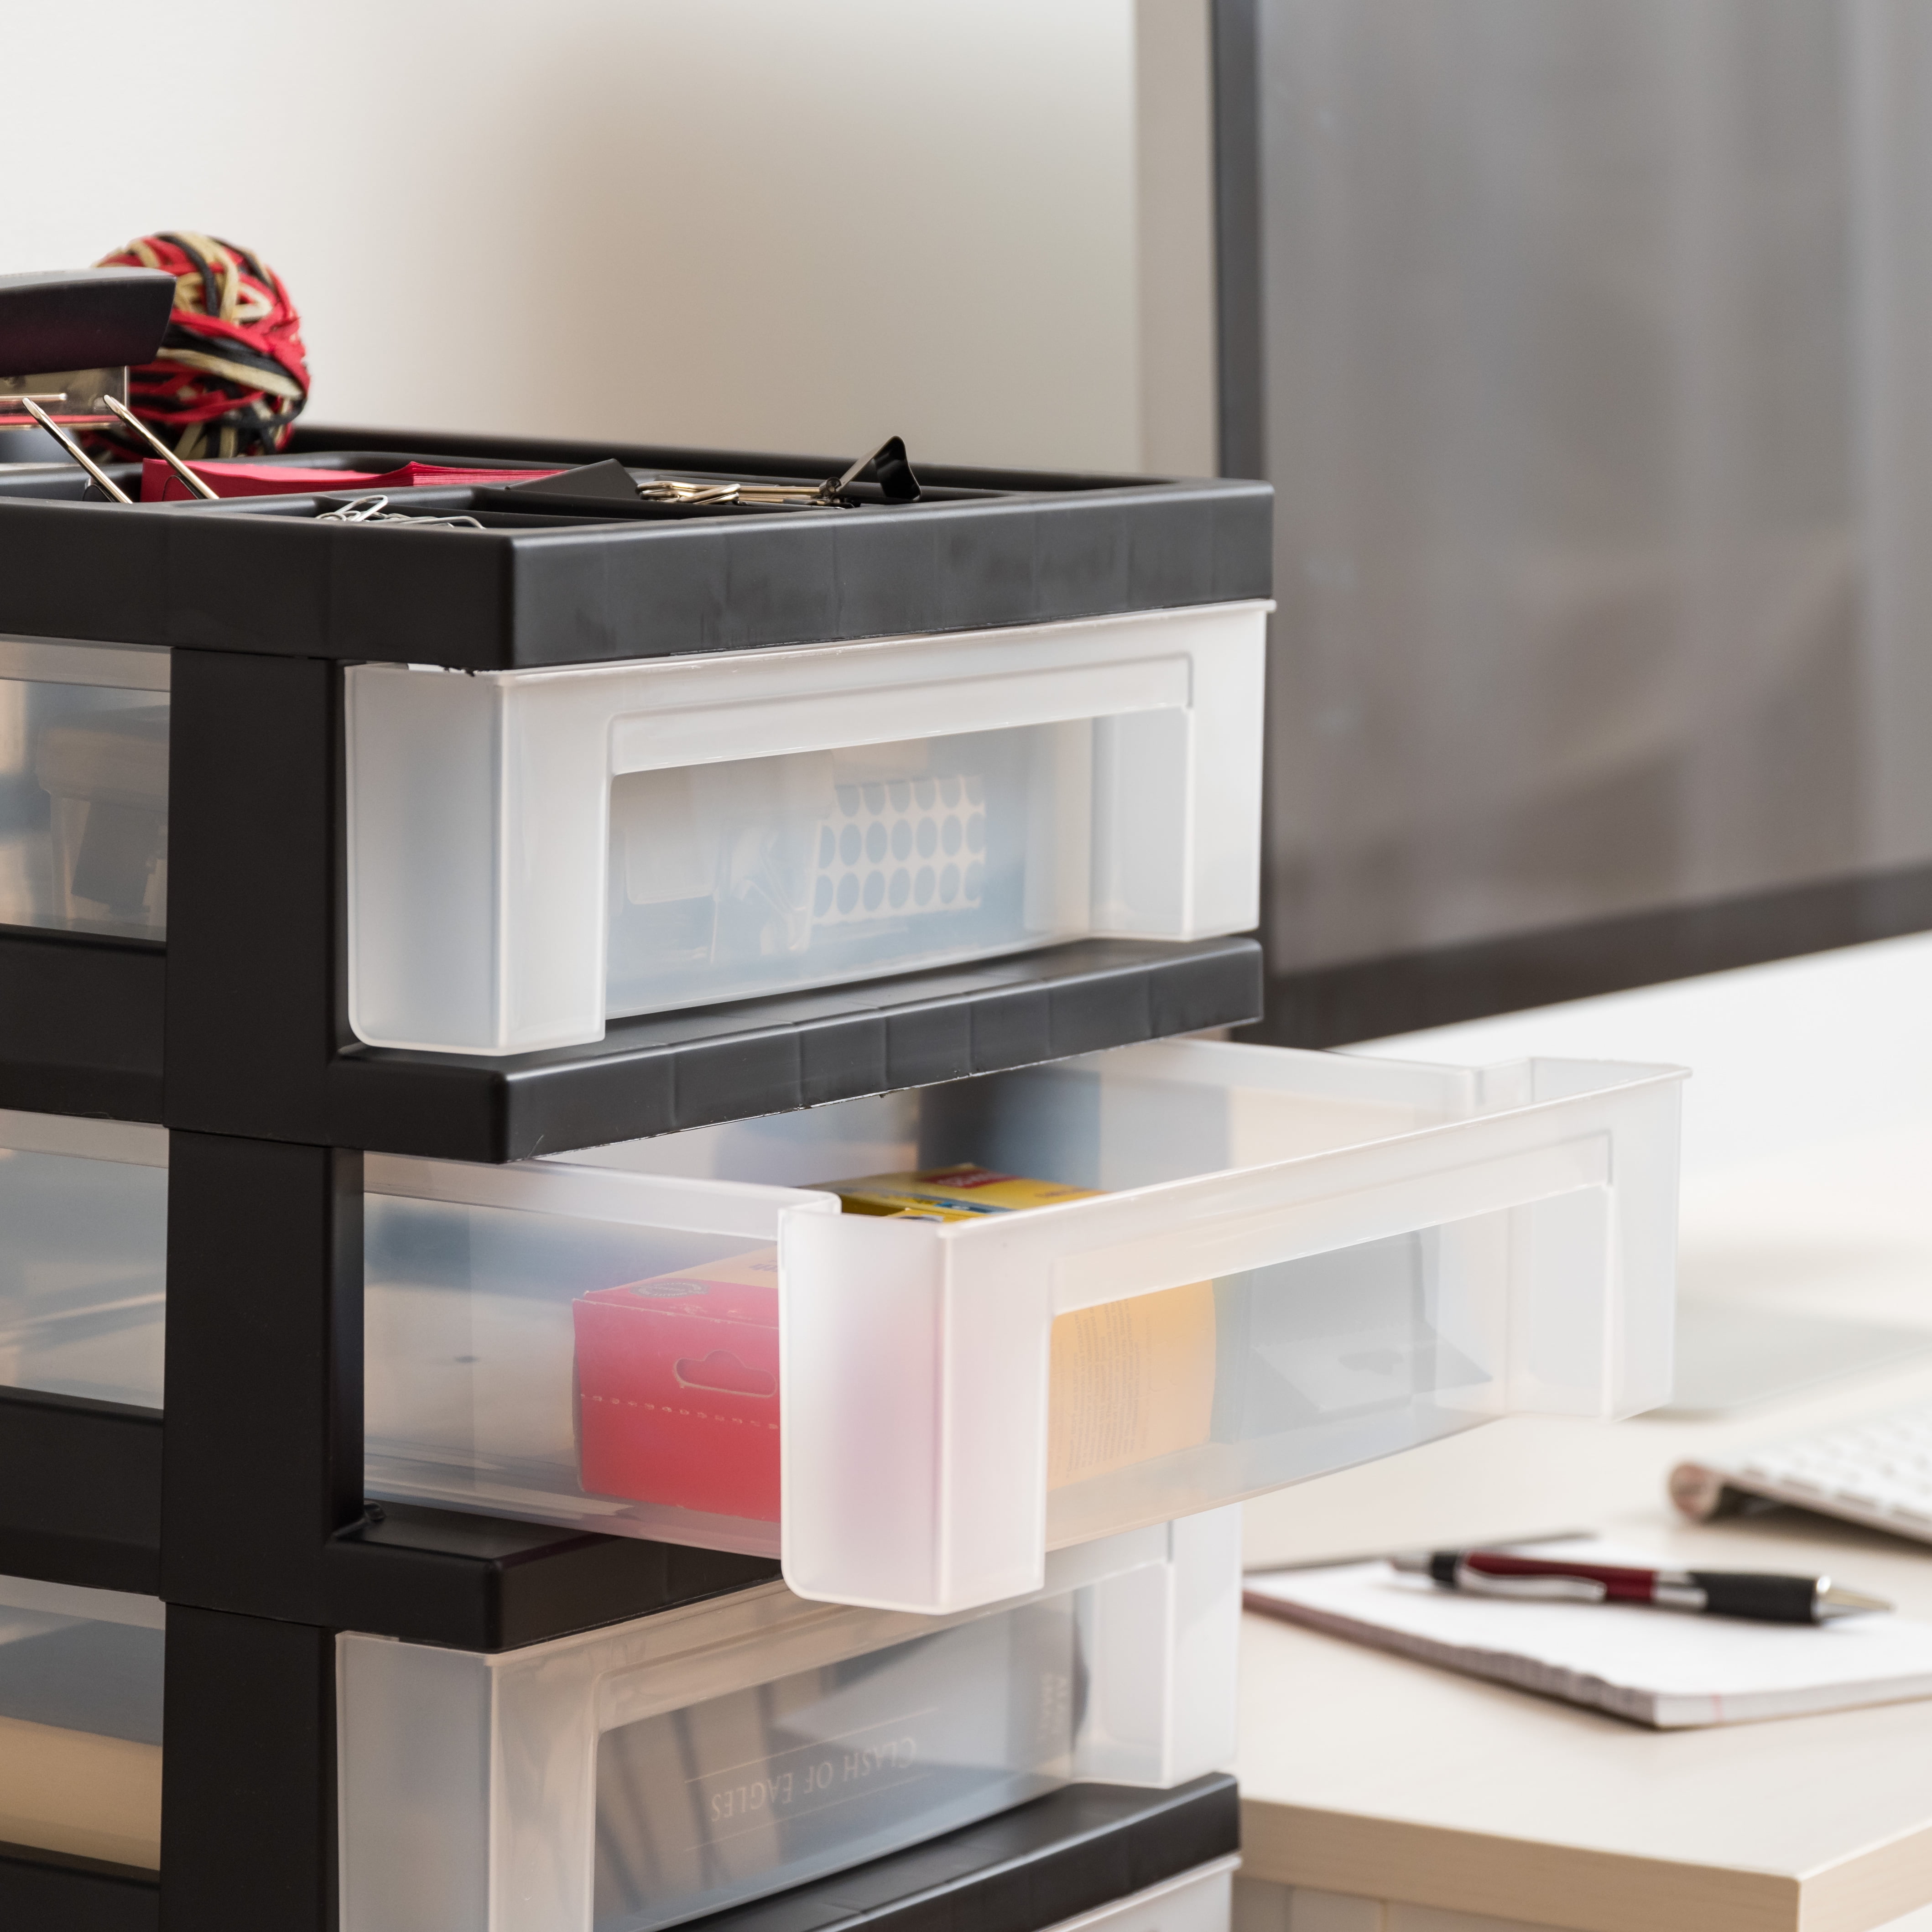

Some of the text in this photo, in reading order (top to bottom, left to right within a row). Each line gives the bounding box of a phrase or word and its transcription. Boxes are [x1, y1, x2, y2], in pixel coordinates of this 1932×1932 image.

[711, 1736, 917, 1822] CLASH OF EAGLES
